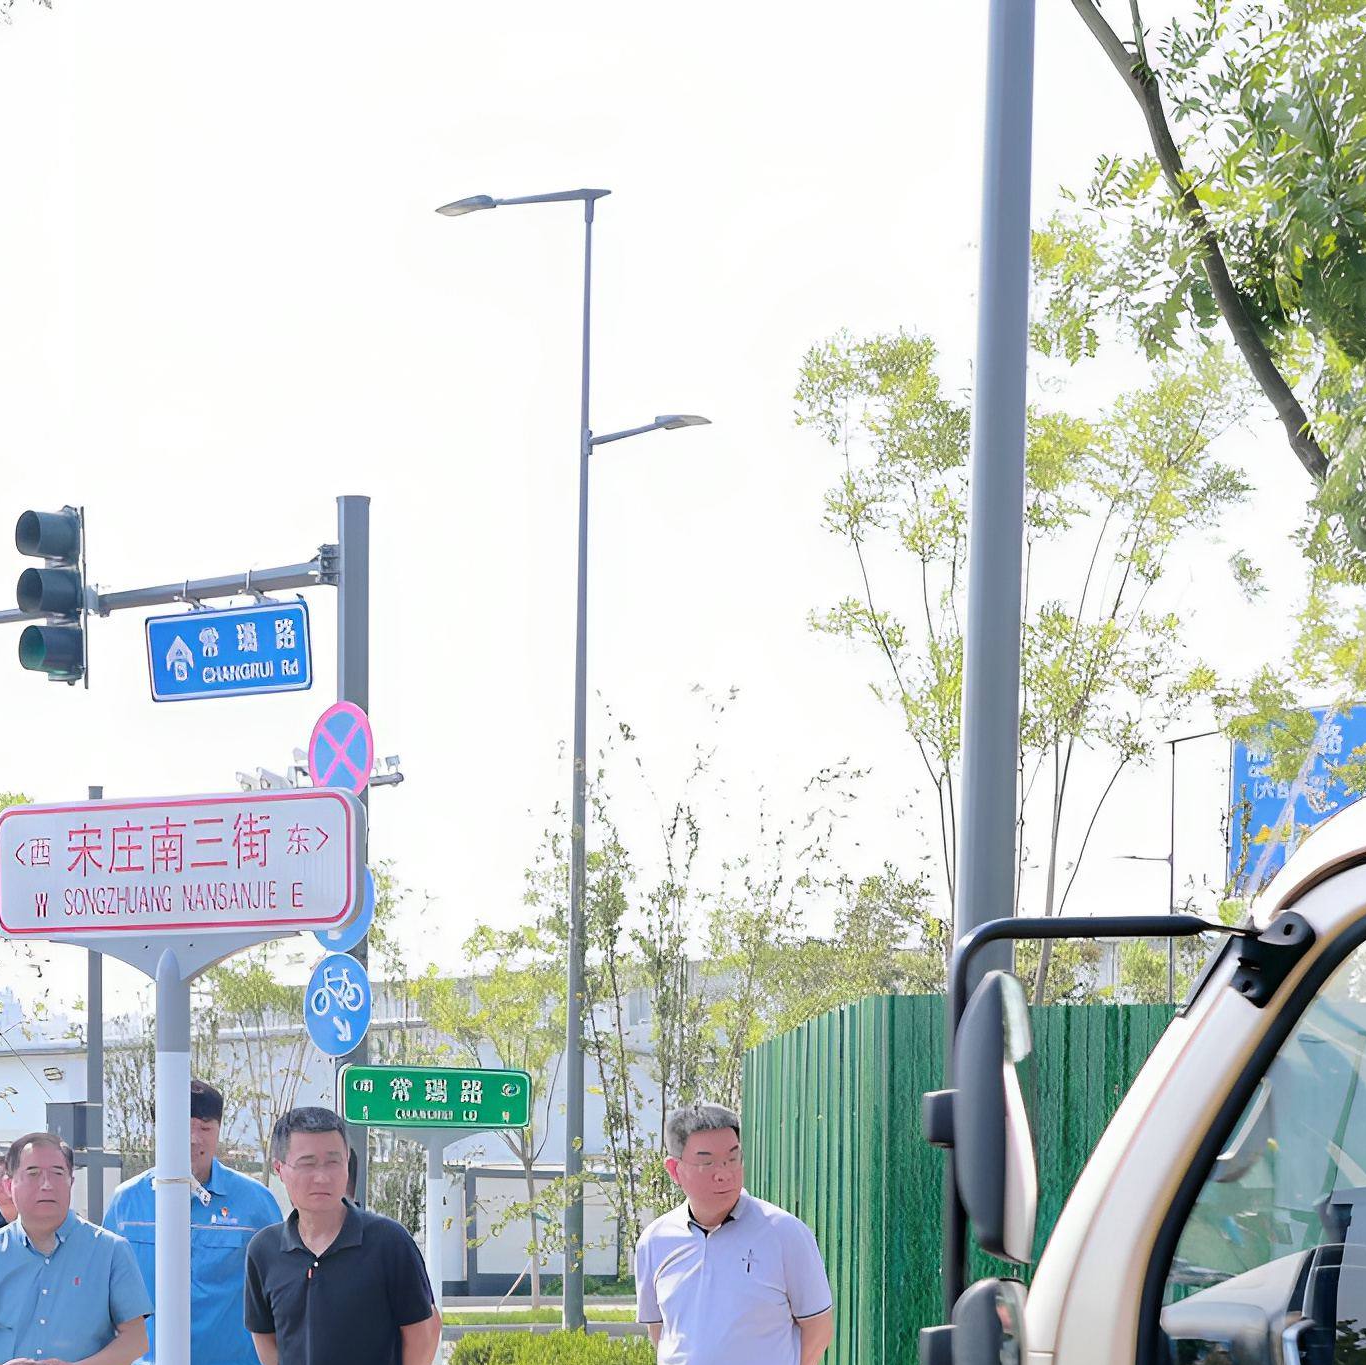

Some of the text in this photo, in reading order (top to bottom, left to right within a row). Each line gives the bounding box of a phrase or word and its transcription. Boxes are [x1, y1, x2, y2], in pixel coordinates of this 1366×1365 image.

[30, 812, 310, 877] 西 宋庄南三街 东
[64, 884, 173, 917] SONGZHUANG
[182, 880, 277, 912] NANSANJIE
[292, 882, 305, 909] E
